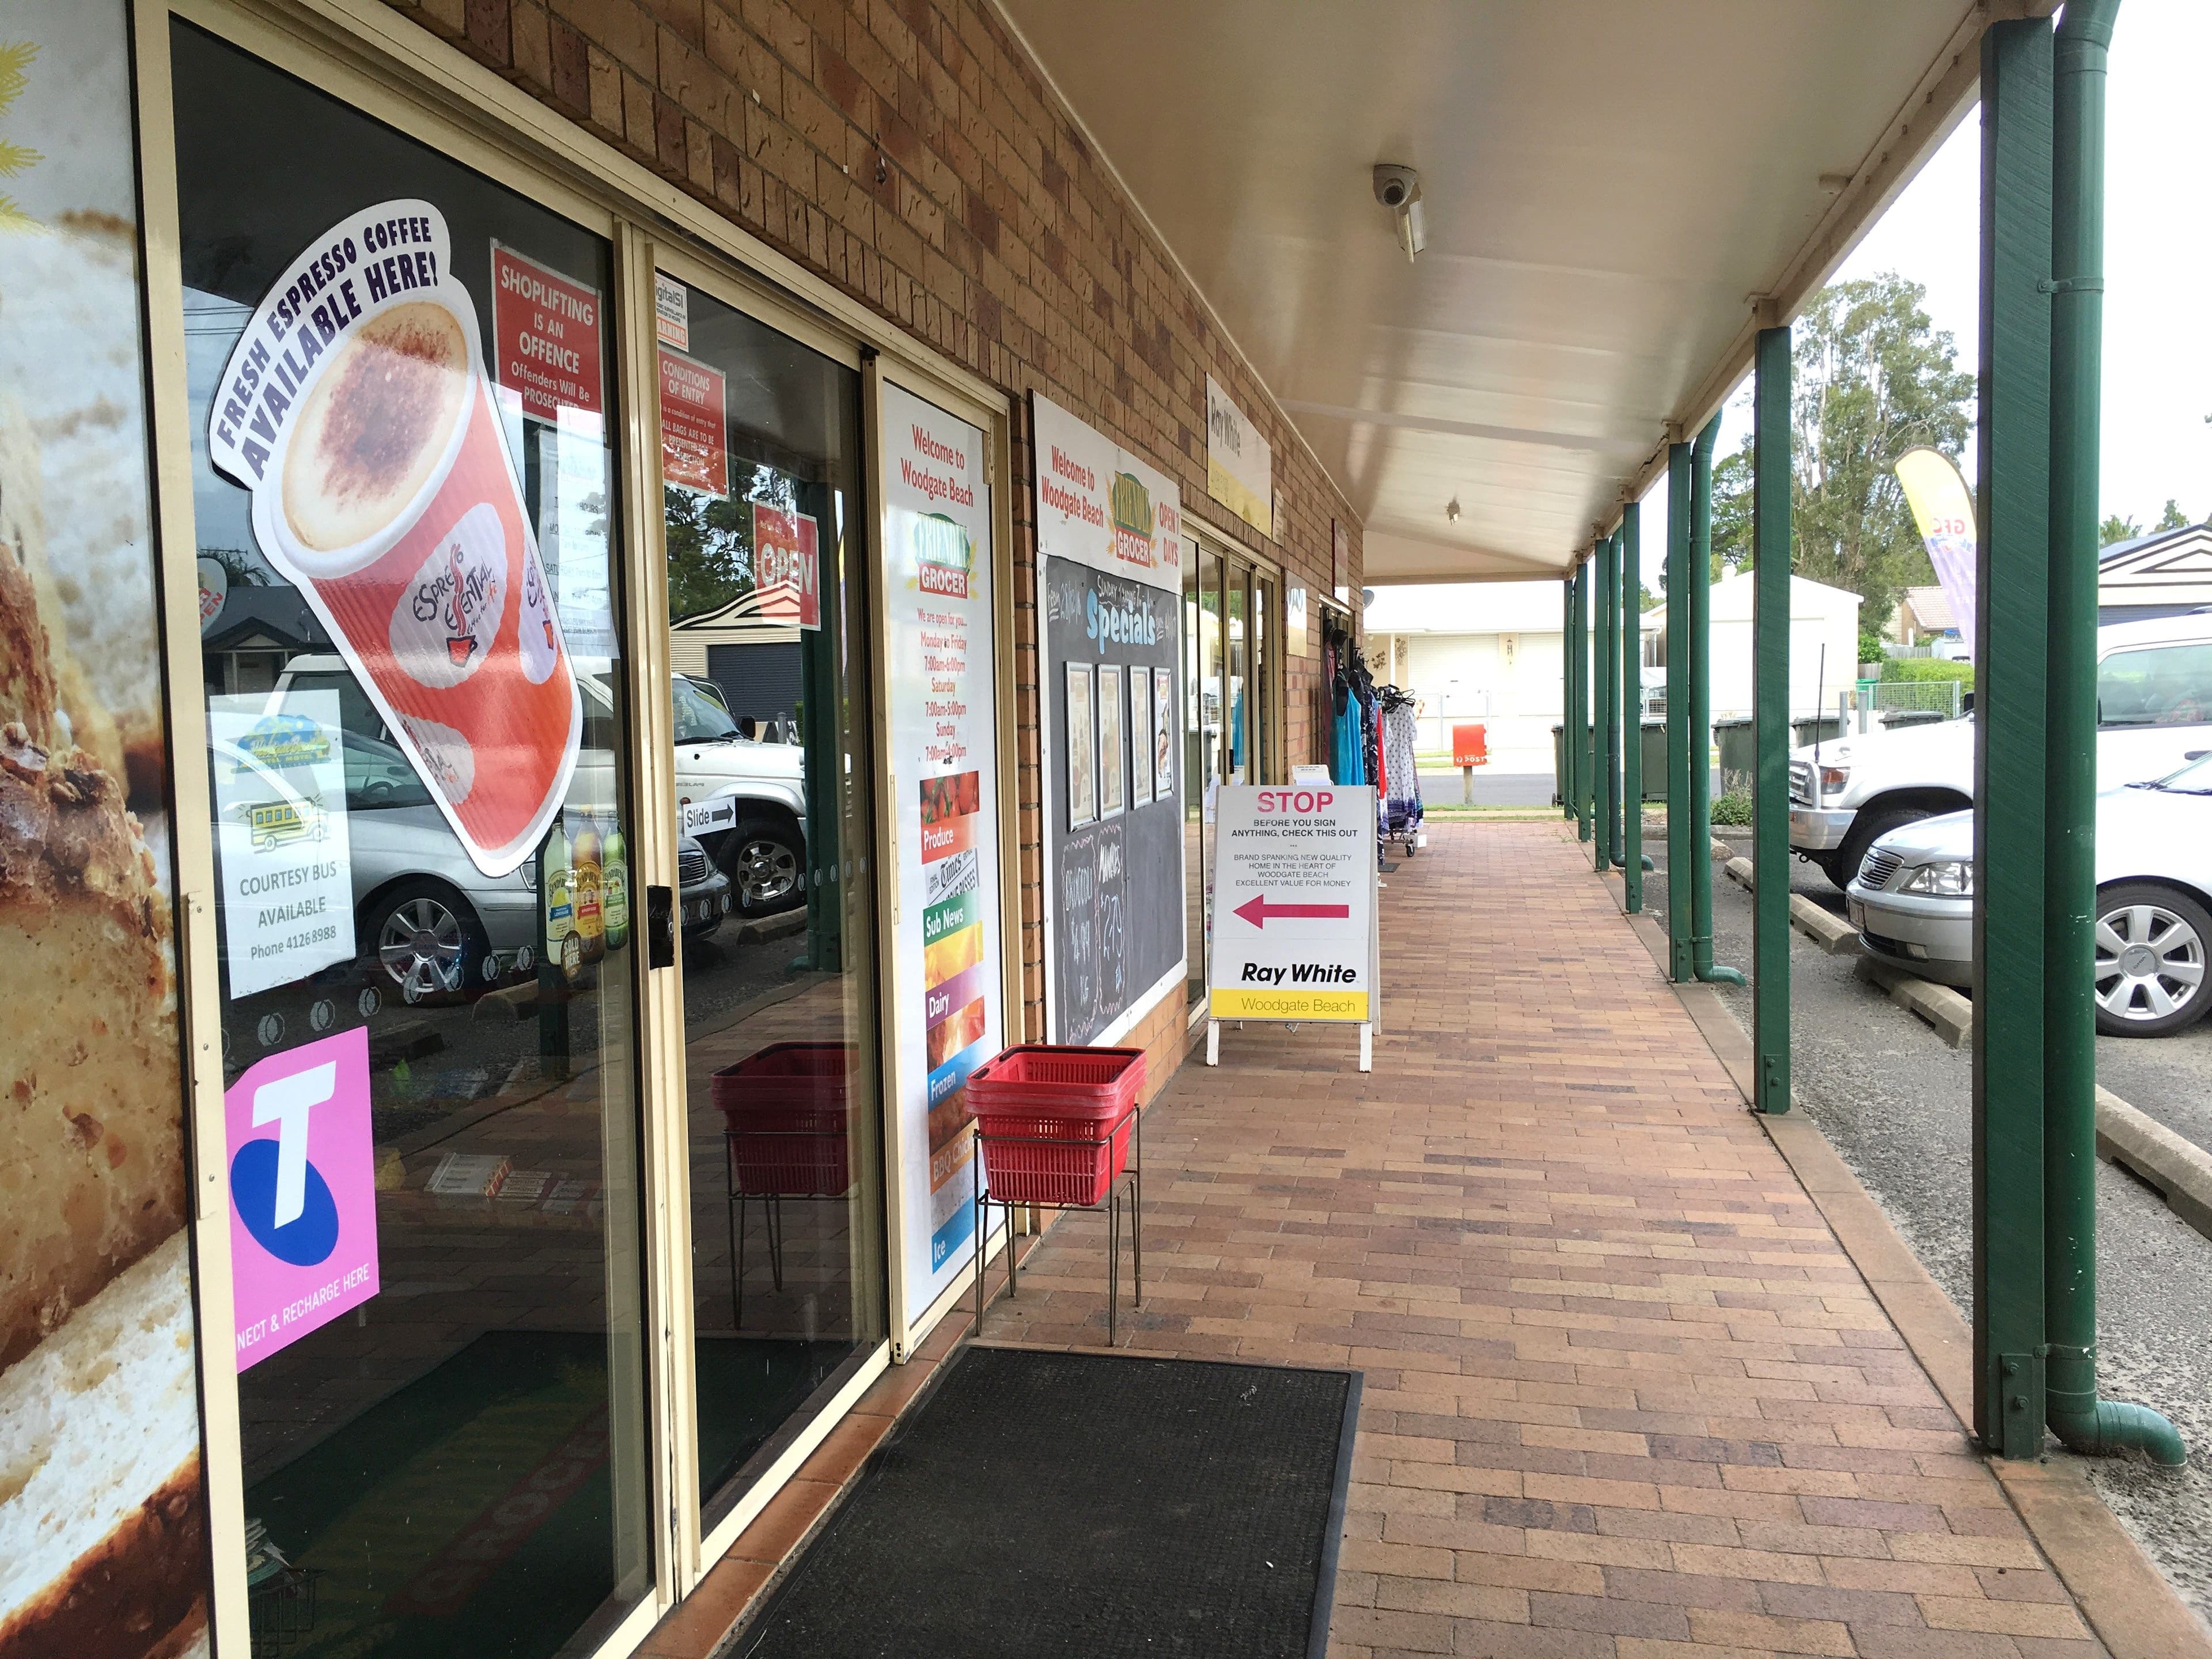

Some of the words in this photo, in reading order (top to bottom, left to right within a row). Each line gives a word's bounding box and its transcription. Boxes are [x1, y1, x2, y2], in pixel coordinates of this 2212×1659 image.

[501, 264, 593, 326] SHOPLIFTING
[217, 338, 271, 449] FRESH
[266, 237, 357, 339] ESPRESSO
[363, 217, 431, 253] COFFEE
[534, 312, 544, 331] IS
[547, 317, 563, 339] AN
[241, 278, 362, 481] AVAILABLE
[364, 251, 438, 303] HERE!
[519, 332, 579, 375] OFFENCE
[511, 362, 556, 393] Offenders
[559, 376, 576, 398] Will
[578, 384, 590, 402] Be
[663, 359, 710, 391] CONDITIONS
[524, 385, 579, 411] PROSEC
[669, 380, 679, 394] OF
[681, 384, 705, 405] ENTRY
[662, 419, 671, 431] ALL
[673, 422, 687, 435] BAGS
[688, 428, 699, 440] ARE
[700, 432, 707, 443] TO
[708, 435, 714, 445] BE
[672, 408, 690, 419] condition
[696, 417, 707, 429] entry
[707, 419, 715, 429] that
[1211, 395, 1224, 448] Ray
[1224, 409, 1240, 457] White
[669, 434, 696, 452] PRESENTED
[912, 423, 953, 465] Welcome
[956, 448, 965, 471] to
[900, 457, 947, 501] Woodgate
[949, 476, 974, 507] Beach
[1051, 445, 1086, 487] Welcome
[1088, 466, 1094, 492] to
[1041, 475, 1081, 519] Woodgate
[1082, 495, 1104, 528] Beach
[1159, 502, 1175, 533] OPEN
[1118, 531, 1149, 563] GROCER
[1164, 537, 1179, 567] DAYS
[760, 543, 813, 595] OPEN
[922, 566, 965, 594] GROCER
[918, 608, 926, 622] We
[927, 612, 935, 624] are
[936, 614, 946, 627] open
[1087, 588, 1156, 655] Specials
[921, 631, 943, 652] Monday
[951, 634, 967, 654] Friday
[931, 677, 956, 696] Saturday
[925, 702, 966, 719] 7:00am-5:00pm
[936, 722, 956, 740] Sunday
[1257, 791, 1334, 813] STOP
[687, 808, 709, 828] Slide
[923, 827, 953, 850] Produce
[240, 869, 309, 897] COURTESY
[312, 861, 337, 881] BUS
[941, 854, 961, 888] Times
[257, 896, 327, 928] AVAILABLE
[926, 915, 941, 938] Sub
[943, 906, 964, 926] News
[251, 936, 284, 961] Phone
[1241, 963, 1287, 986] Ray
[1291, 964, 1356, 983] White
[929, 991, 950, 1019] Dairy
[1241, 998, 1309, 1014] Woodgate
[1313, 999, 1355, 1012] Beach
[930, 1069, 956, 1101] Frozen
[252, 1060, 336, 1229] T
[934, 1150, 950, 1182] BBQ
[933, 1240, 946, 1264] Ice
[270, 1313, 279, 1332] &
[282, 1277, 340, 1325] RECHARGE
[343, 1263, 370, 1291] HERE
